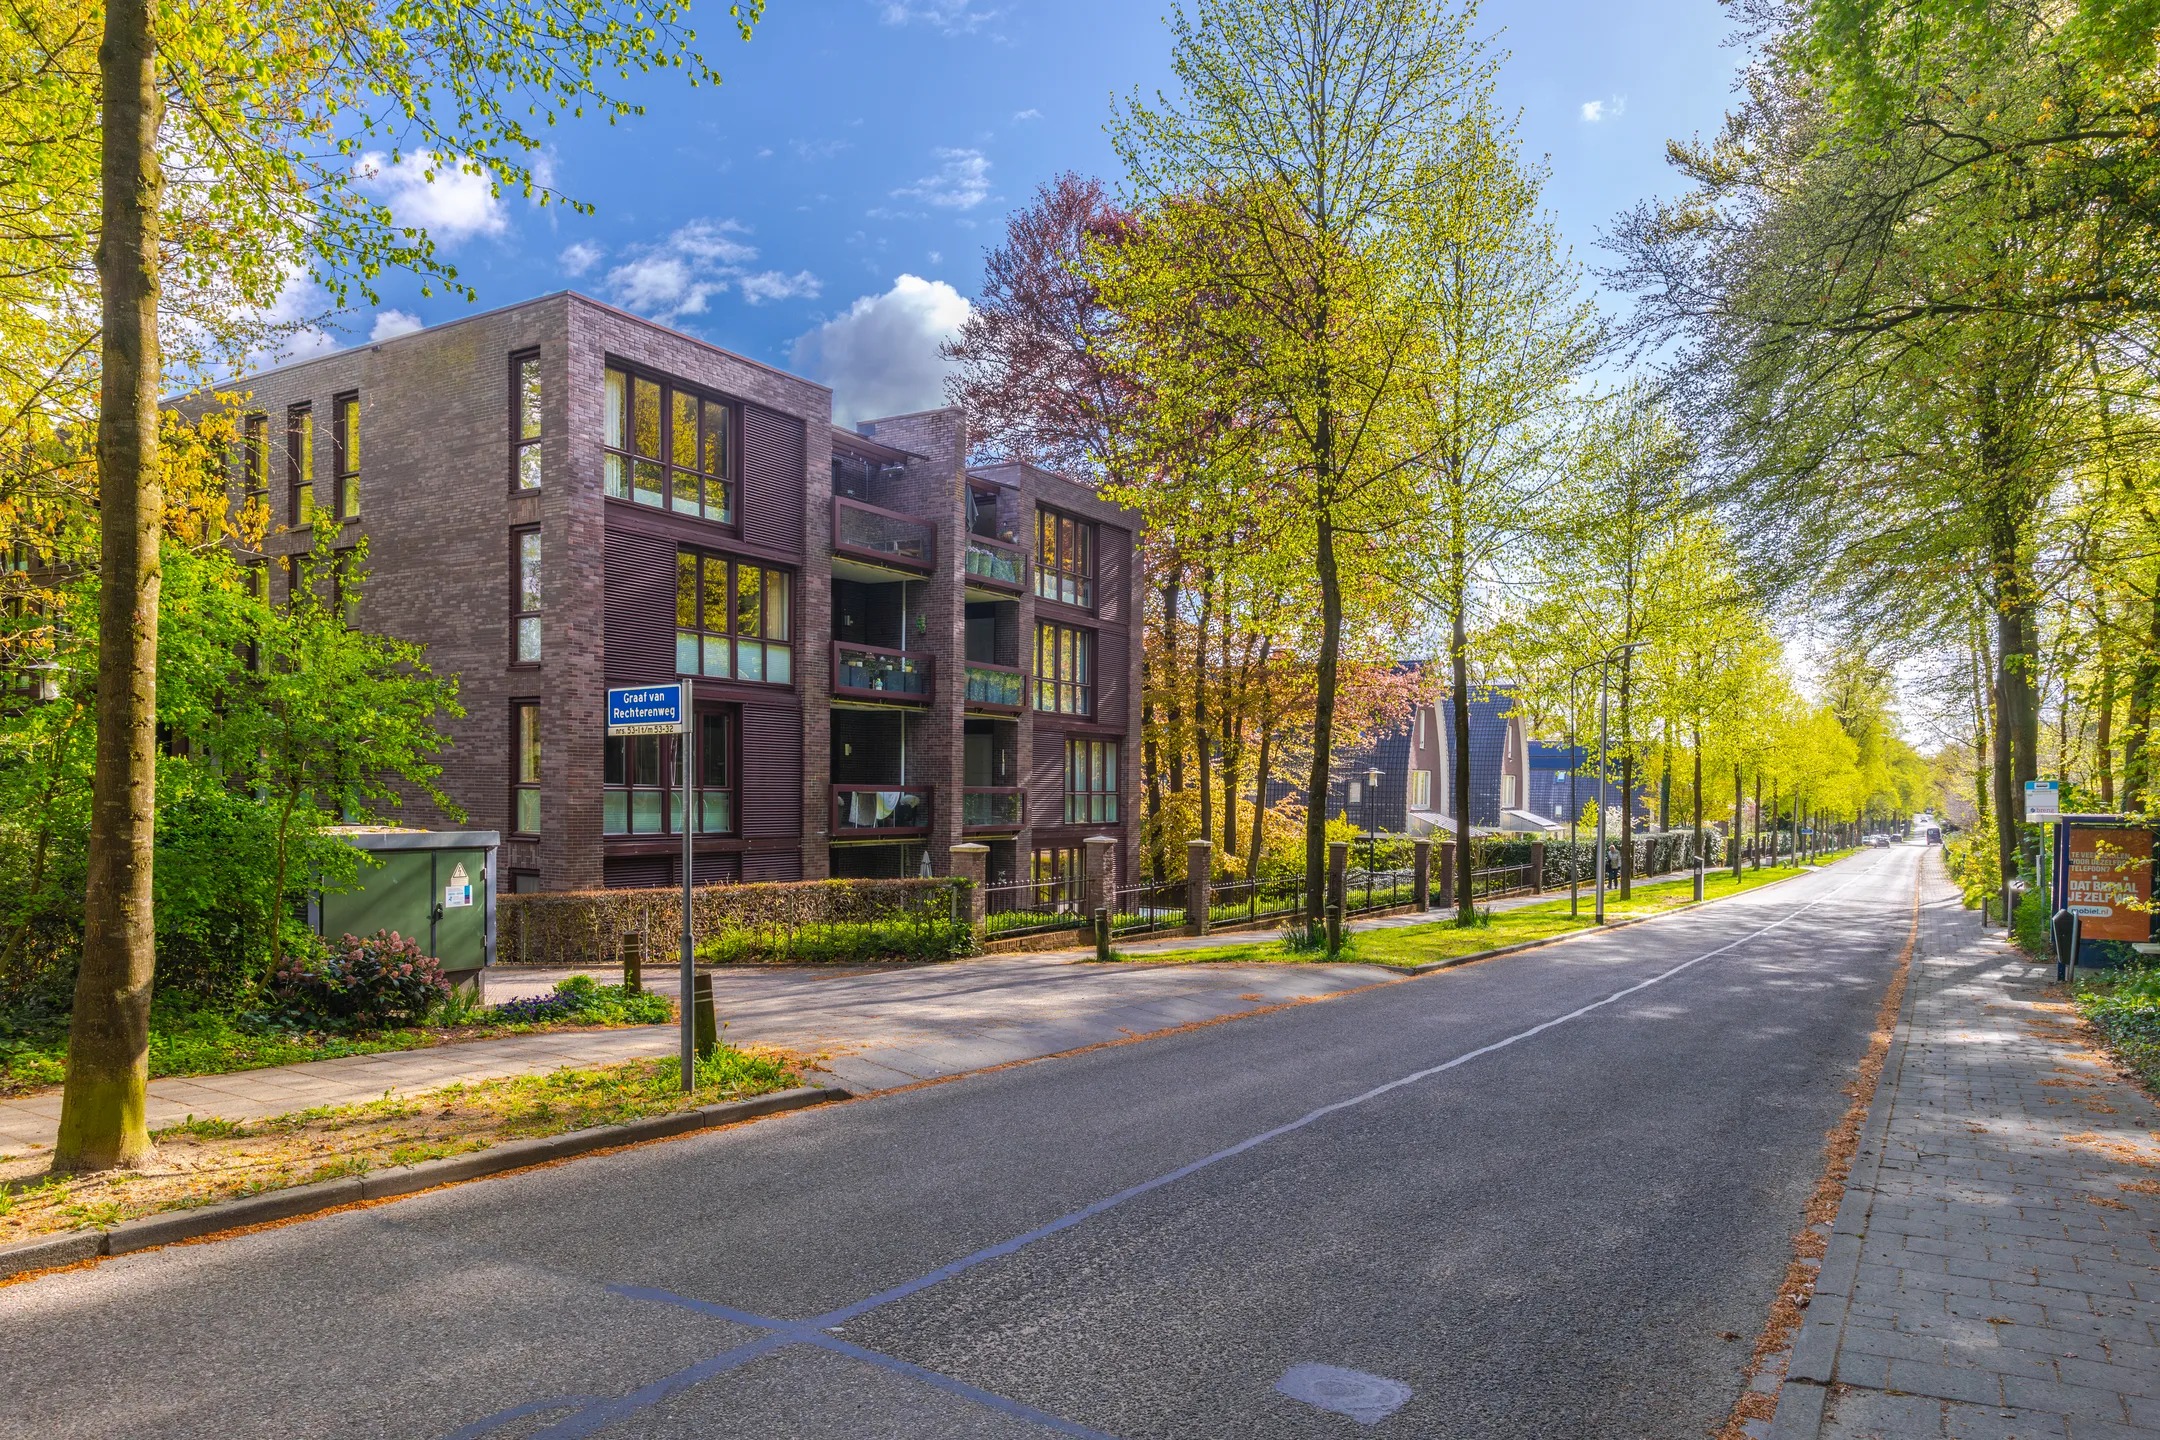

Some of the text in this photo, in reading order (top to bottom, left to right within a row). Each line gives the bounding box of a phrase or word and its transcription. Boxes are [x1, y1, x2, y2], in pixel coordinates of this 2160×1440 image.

[623, 692, 665, 703] Graaf van
[613, 707, 675, 718] Rechterenweg
[654, 725, 674, 733] 53-32
[2100, 852, 2130, 860] EALEN
[2069, 880, 2091, 891] DAT
[2068, 891, 2082, 902] JE
[2083, 892, 2112, 903] ZELF
